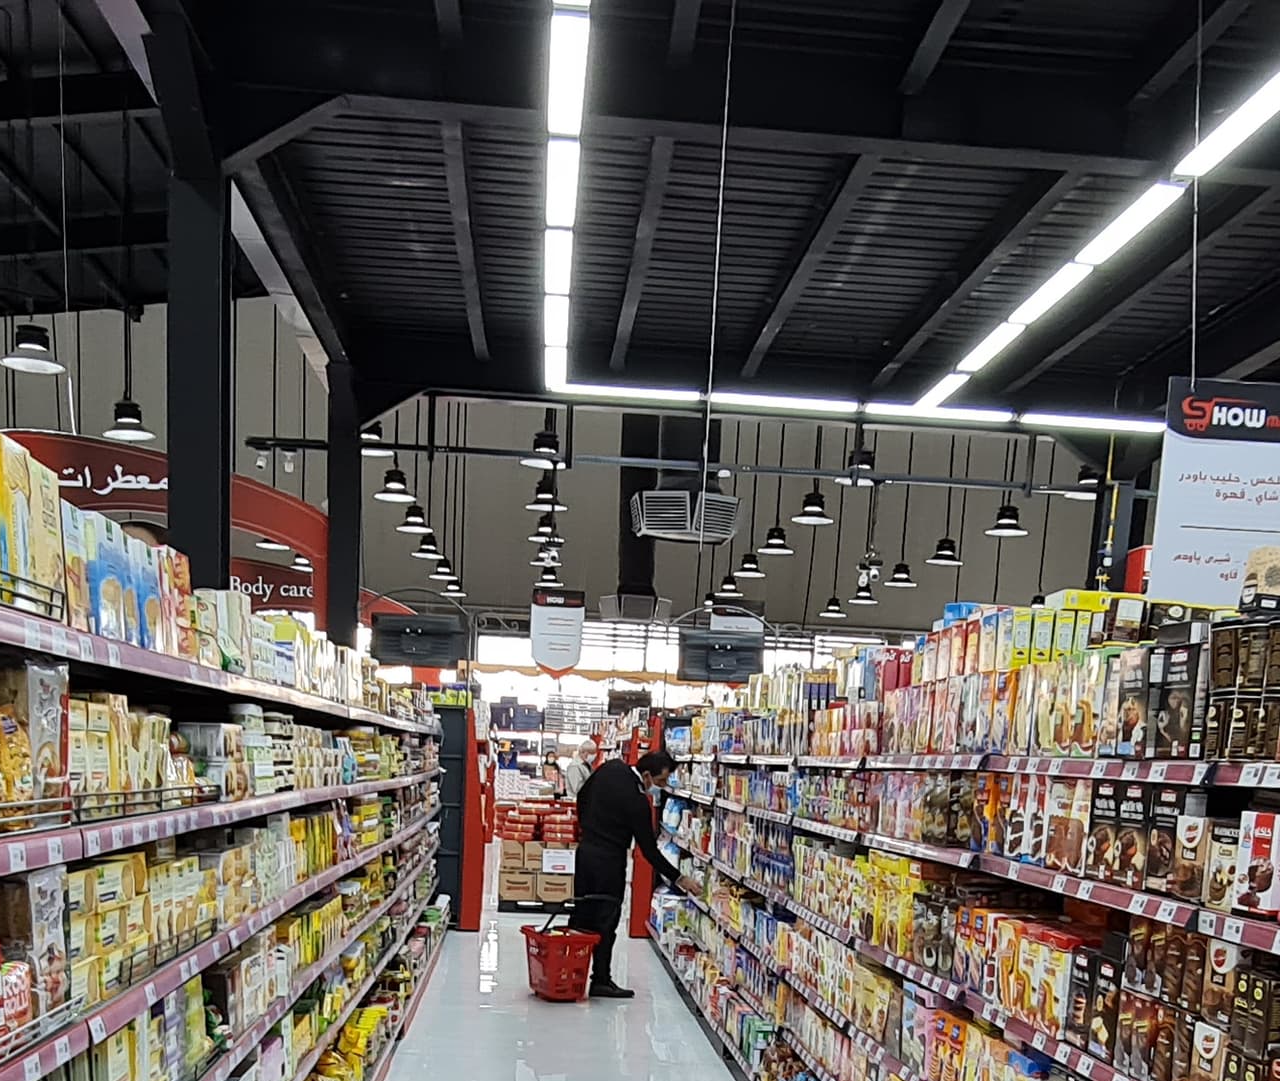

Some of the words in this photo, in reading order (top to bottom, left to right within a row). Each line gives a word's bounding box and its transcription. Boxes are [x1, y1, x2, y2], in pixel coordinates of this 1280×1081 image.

[1182, 395, 1267, 432] SHOW
[59, 464, 168, 497] معطرات
[1179, 470, 1208, 483] باودر
[1215, 488, 1246, 501] قهوة
[1255, 490, 1279, 506] شاي
[230, 575, 274, 603] Body
[279, 582, 314, 599] care
